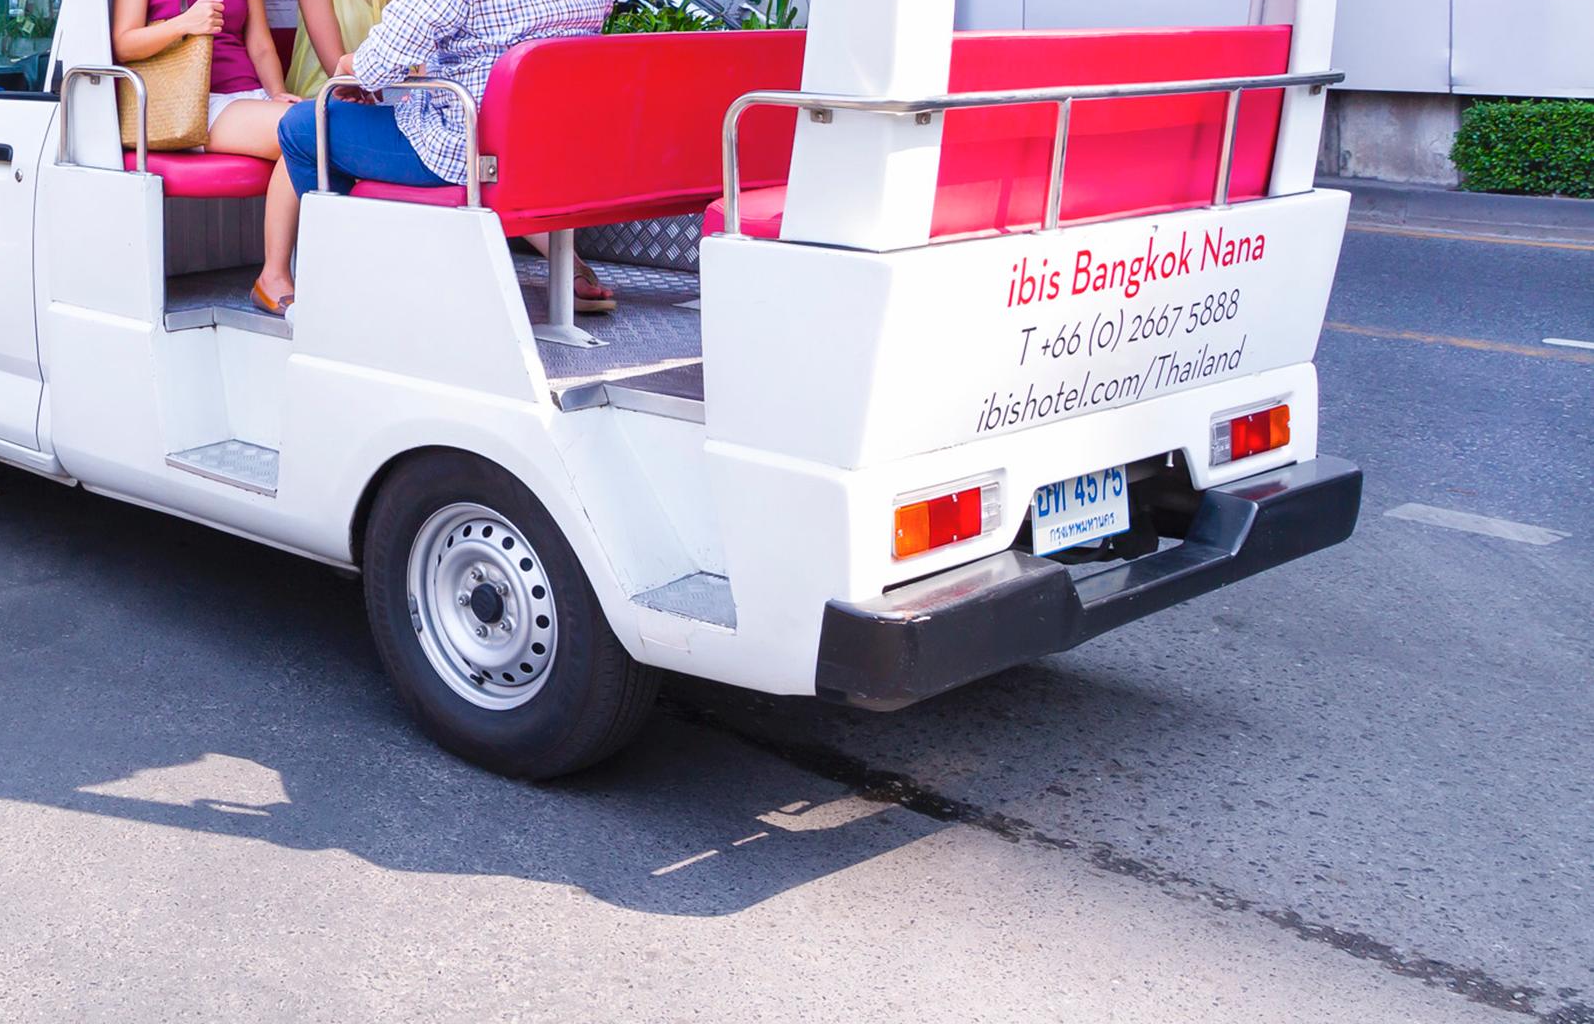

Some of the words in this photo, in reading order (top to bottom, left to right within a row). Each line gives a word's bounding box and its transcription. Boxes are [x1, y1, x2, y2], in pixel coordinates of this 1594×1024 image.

[1007, 256, 1061, 308] ibis
[1071, 230, 1193, 299] Bangkok
[1200, 226, 1266, 271] Nana
[1019, 326, 1037, 366] T
[1041, 321, 1082, 358] +66
[1127, 303, 1183, 343] 2667
[1185, 288, 1240, 334] 5888
[976, 334, 1247, 433] ibishotel.com/Thailand
[1049, 512, 1115, 545] กรุงเทพมหานคร
